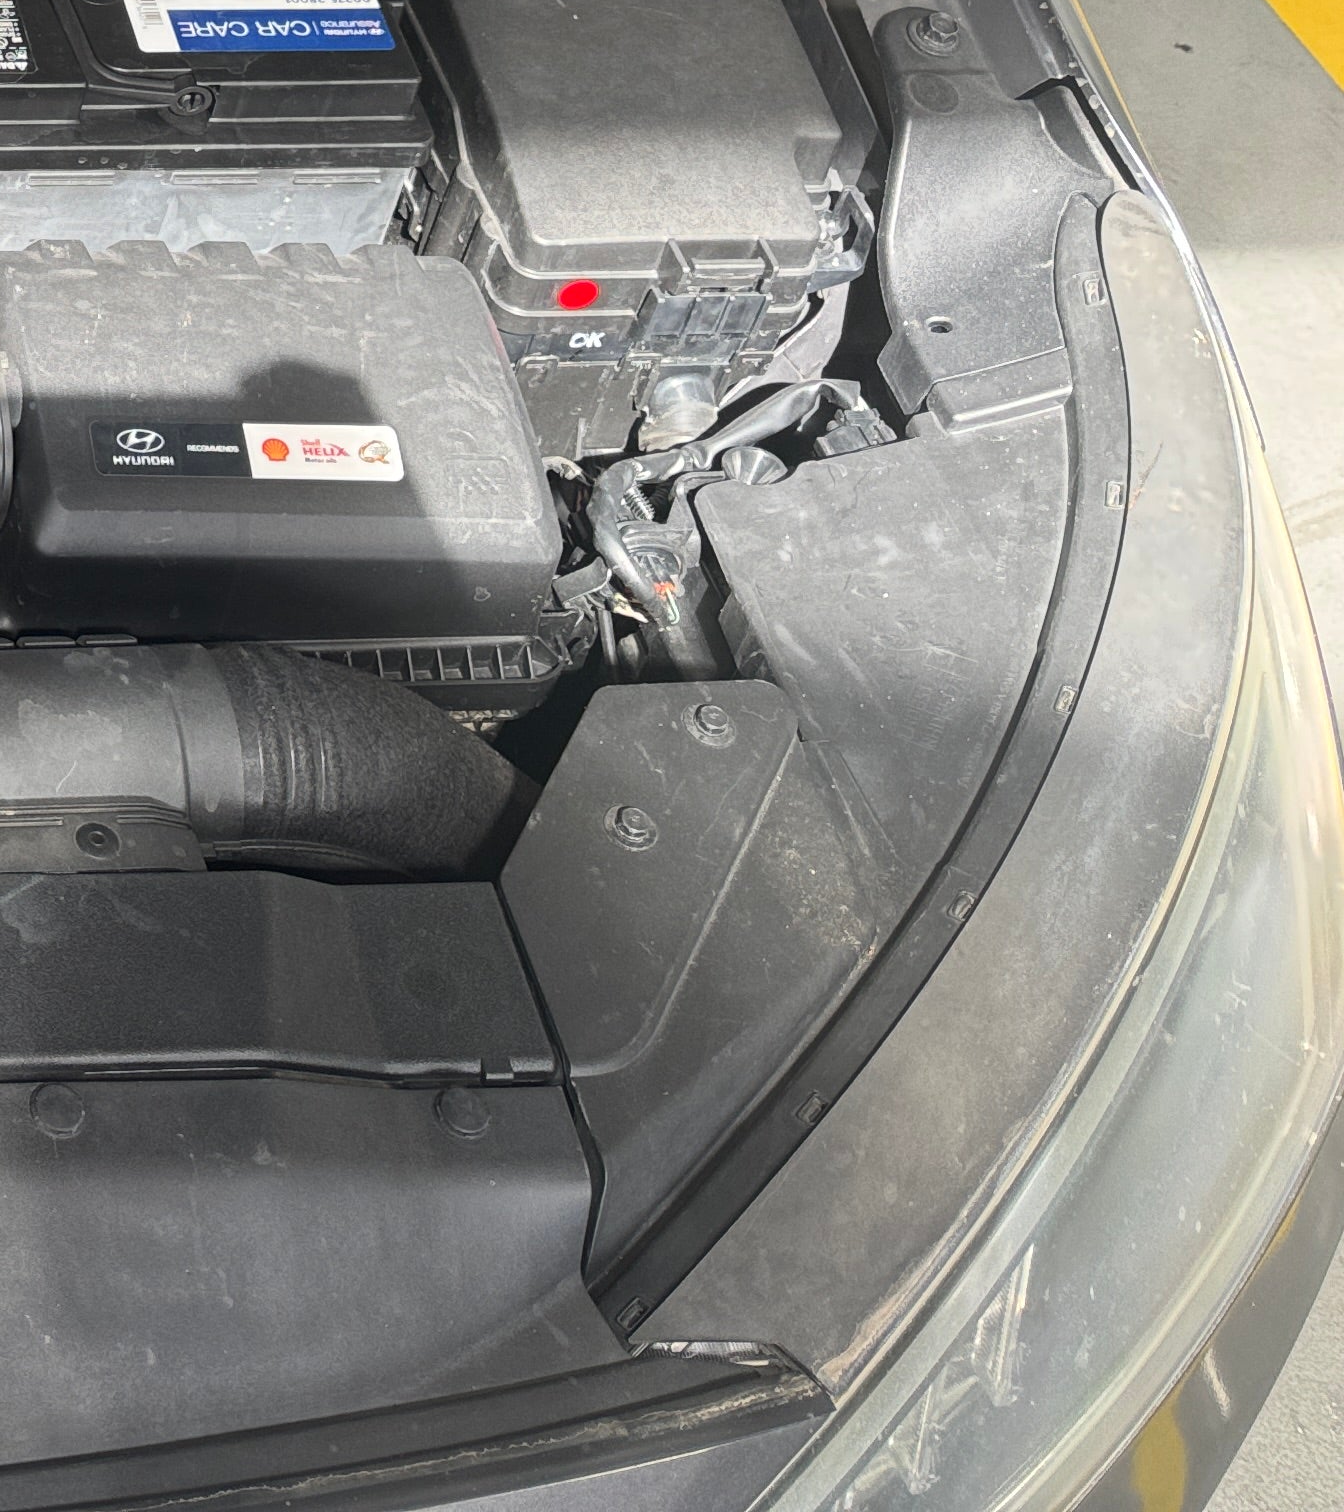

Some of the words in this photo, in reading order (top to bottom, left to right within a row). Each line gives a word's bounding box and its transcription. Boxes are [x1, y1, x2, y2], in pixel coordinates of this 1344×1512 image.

[177, 20, 249, 38] CARE
[255, 20, 311, 37] CAR
[320, 20, 381, 28] Assurance
[324, 28, 366, 36] HYUNDAI
[569, 331, 606, 348] OK
[303, 448, 349, 457] HELIX
[112, 455, 175, 466] HYUNDAI
